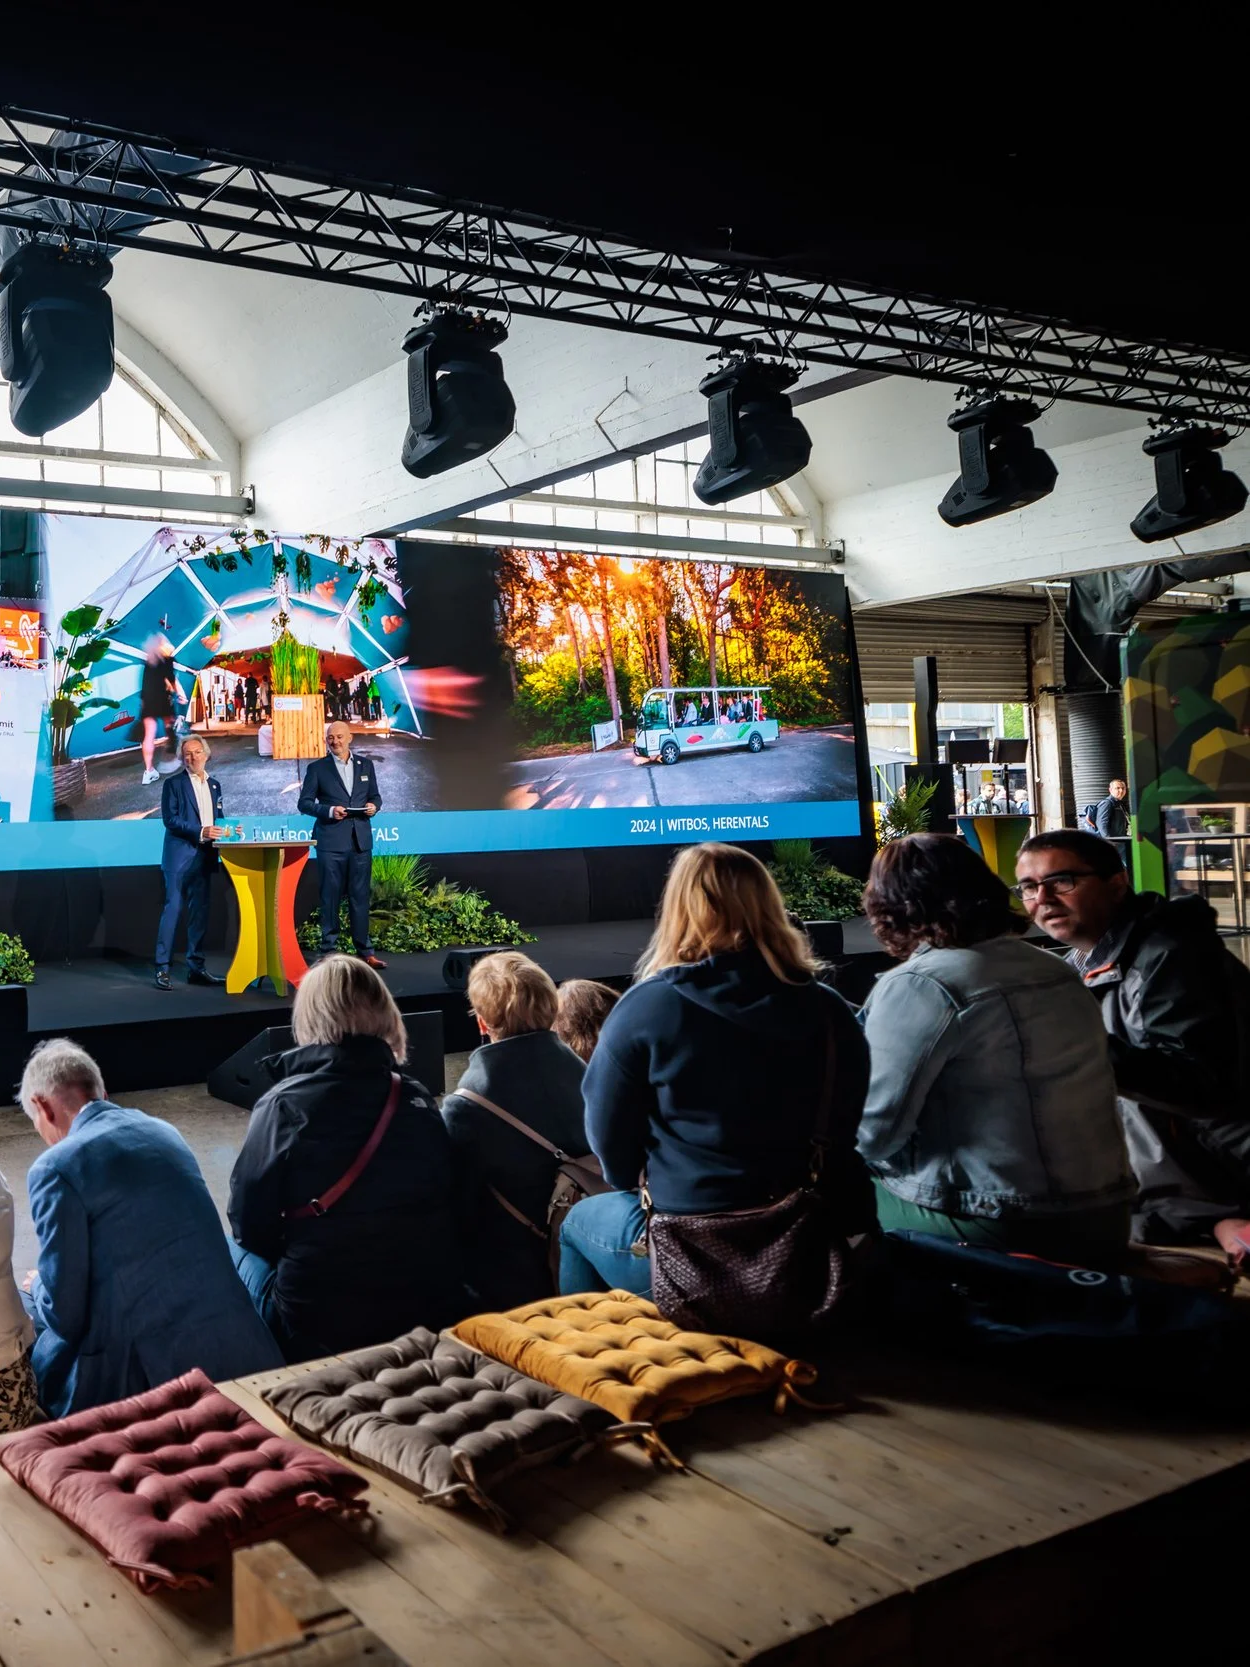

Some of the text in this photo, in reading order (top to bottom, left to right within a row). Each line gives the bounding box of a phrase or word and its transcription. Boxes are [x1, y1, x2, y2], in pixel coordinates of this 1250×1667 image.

[630, 819, 657, 833] 2024
[667, 818, 711, 832] WITBOS,
[712, 816, 770, 830] HERENTALS
